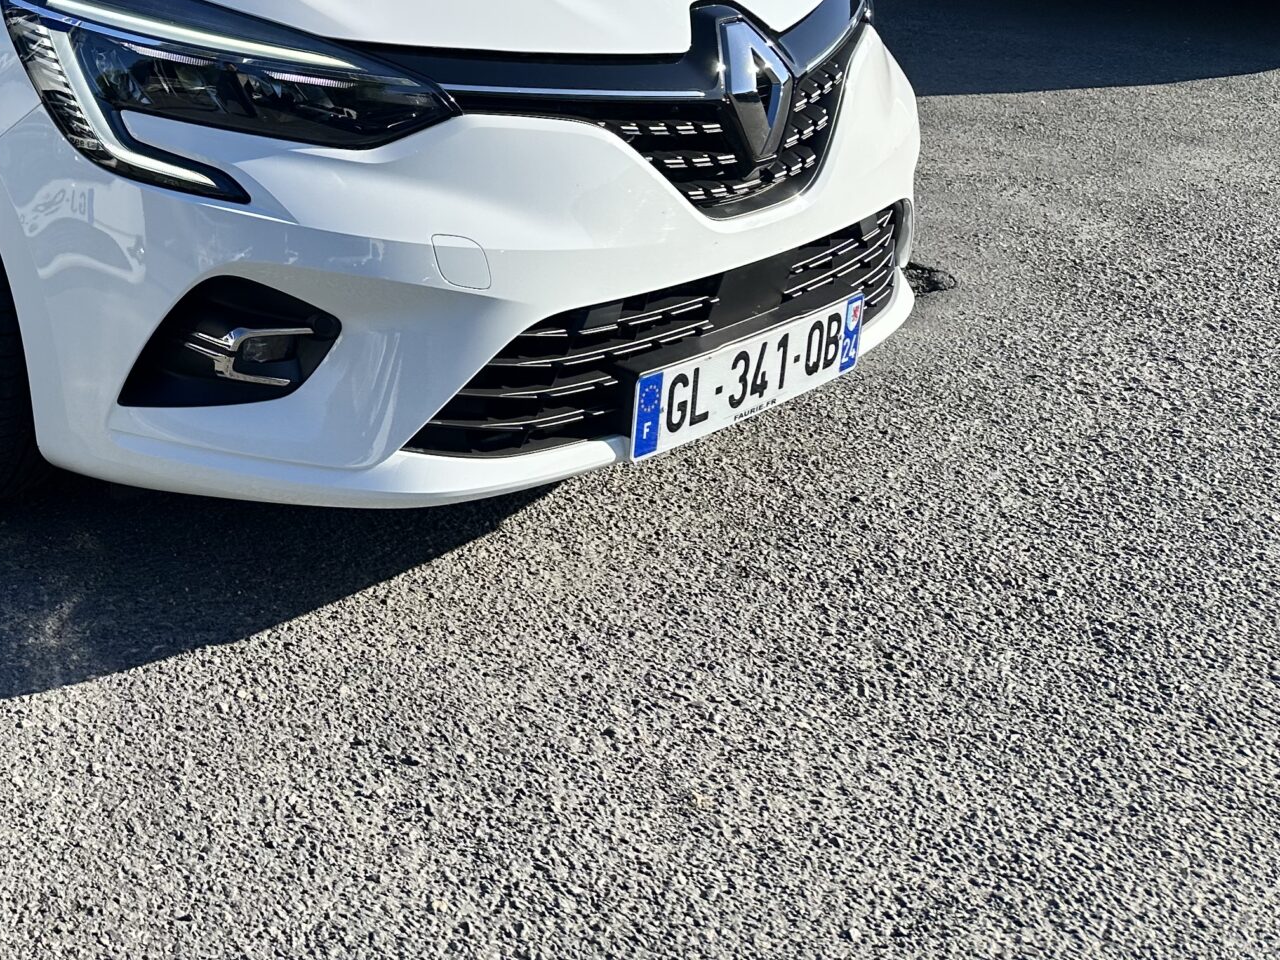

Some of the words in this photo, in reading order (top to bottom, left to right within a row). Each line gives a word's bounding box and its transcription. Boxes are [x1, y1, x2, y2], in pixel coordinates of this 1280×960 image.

[840, 337, 857, 364] 24
[666, 312, 842, 433] GL-341-QB
[734, 398, 777, 421] FAURIE.FR
[642, 421, 651, 440] F
